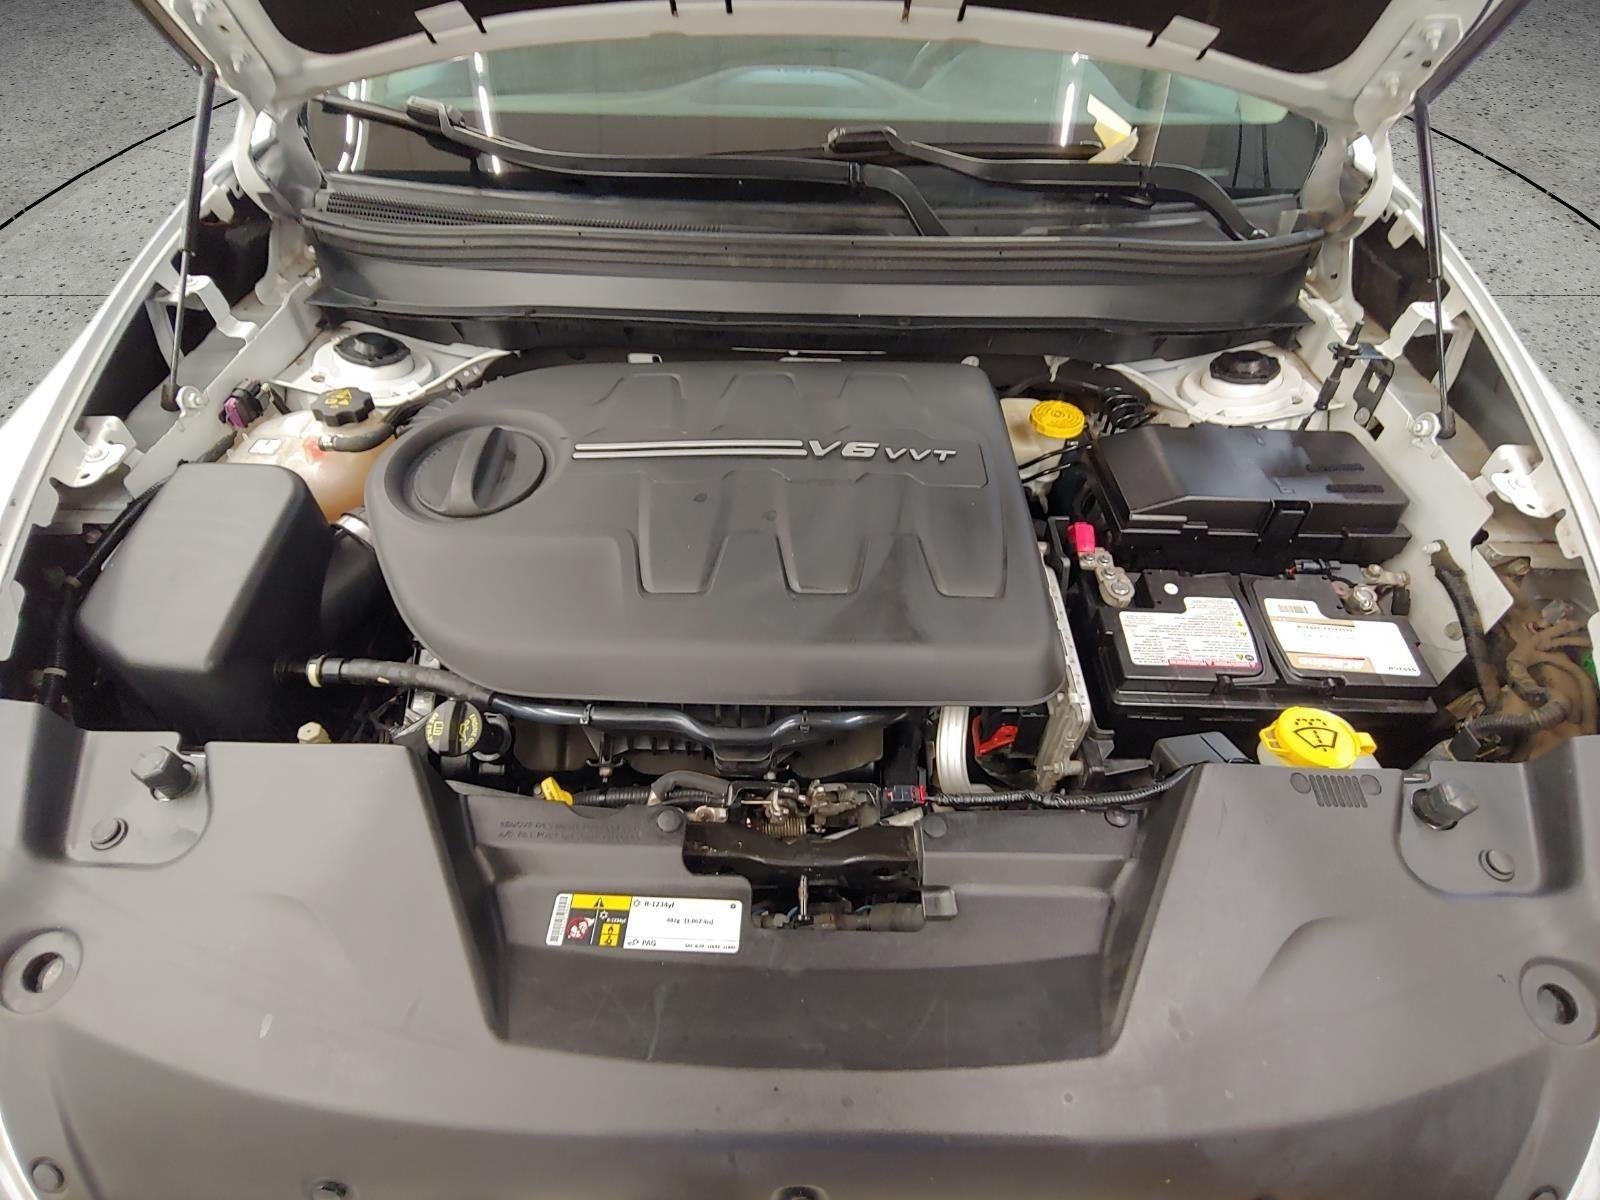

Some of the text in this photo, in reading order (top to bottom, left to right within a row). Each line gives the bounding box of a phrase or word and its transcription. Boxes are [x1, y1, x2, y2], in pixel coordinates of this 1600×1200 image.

[808, 440, 958, 463] V6 VVT
[641, 939, 657, 947] PAG
